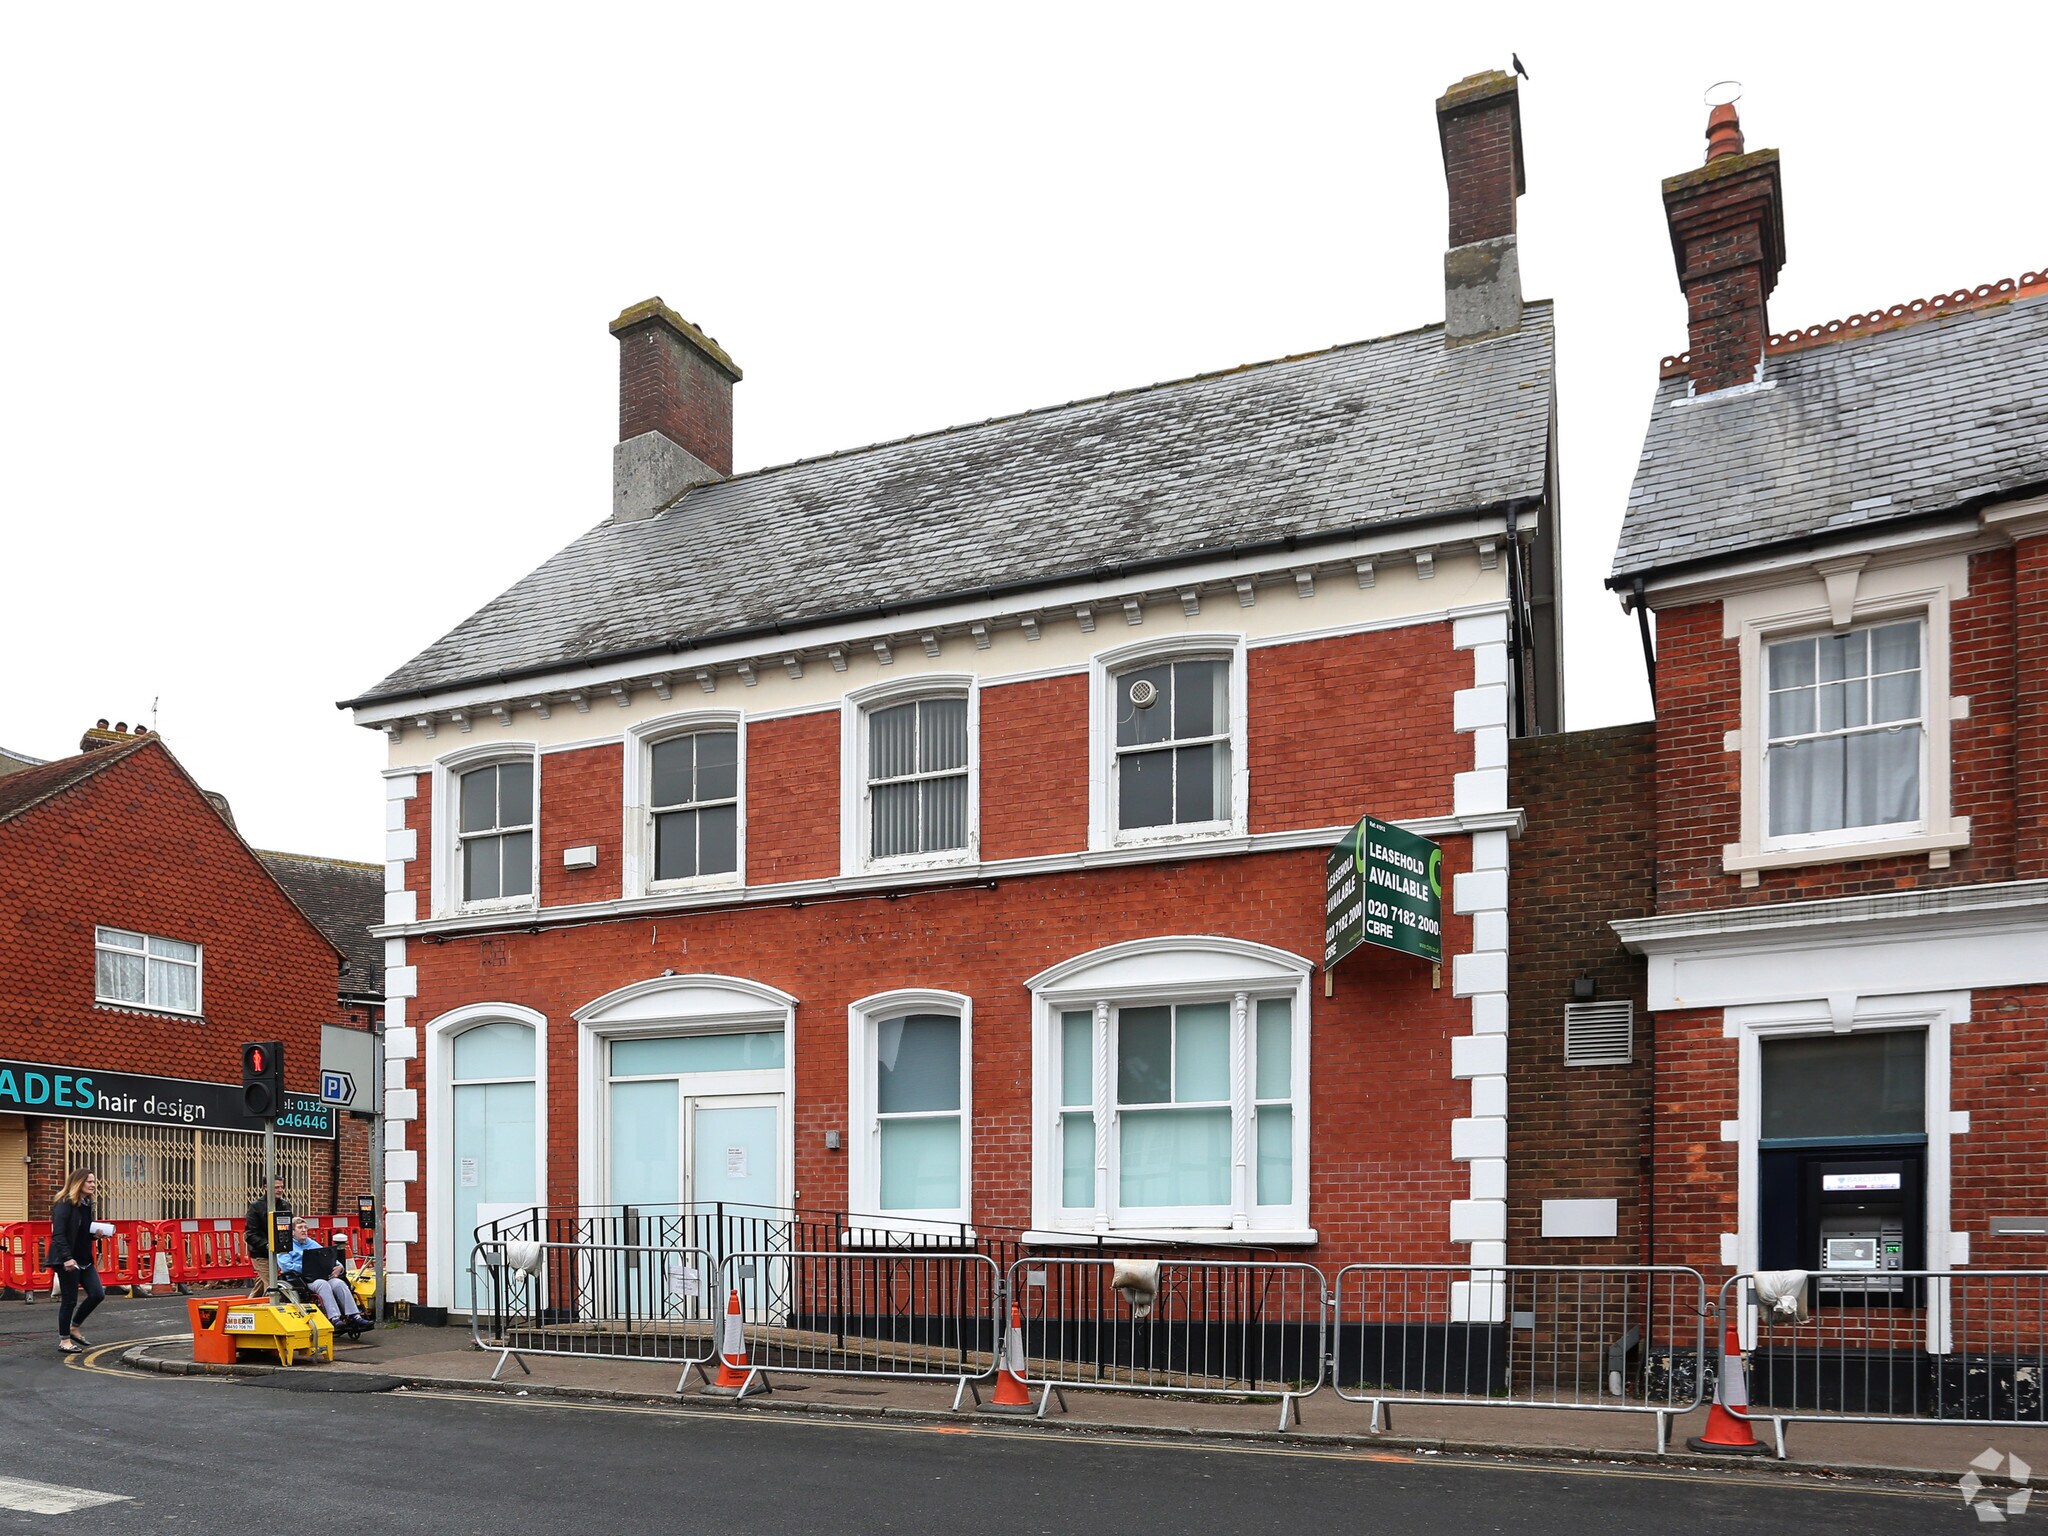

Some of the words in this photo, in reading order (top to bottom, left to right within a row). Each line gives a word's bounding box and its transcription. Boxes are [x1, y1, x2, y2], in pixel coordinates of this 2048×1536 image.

[1327, 854, 1354, 892] LEASEHOLD
[1369, 841, 1424, 876] LEASEHOLD
[1327, 874, 1356, 916] AVAILABLE
[1368, 866, 1429, 902] AVAILABLE
[1326, 924, 1335, 944] 020
[1335, 912, 1348, 936] 7182
[1349, 901, 1362, 926] 2000
[1366, 919, 1393, 939] CBRE
[1368, 899, 1388, 919] 020
[1391, 906, 1416, 928] 7182
[1417, 915, 1439, 936] 2000
[1324, 941, 1337, 961] CBRE
[328, 1079, 338, 1096] P
[97, 1089, 138, 1113] hair
[143, 1095, 206, 1122] design
